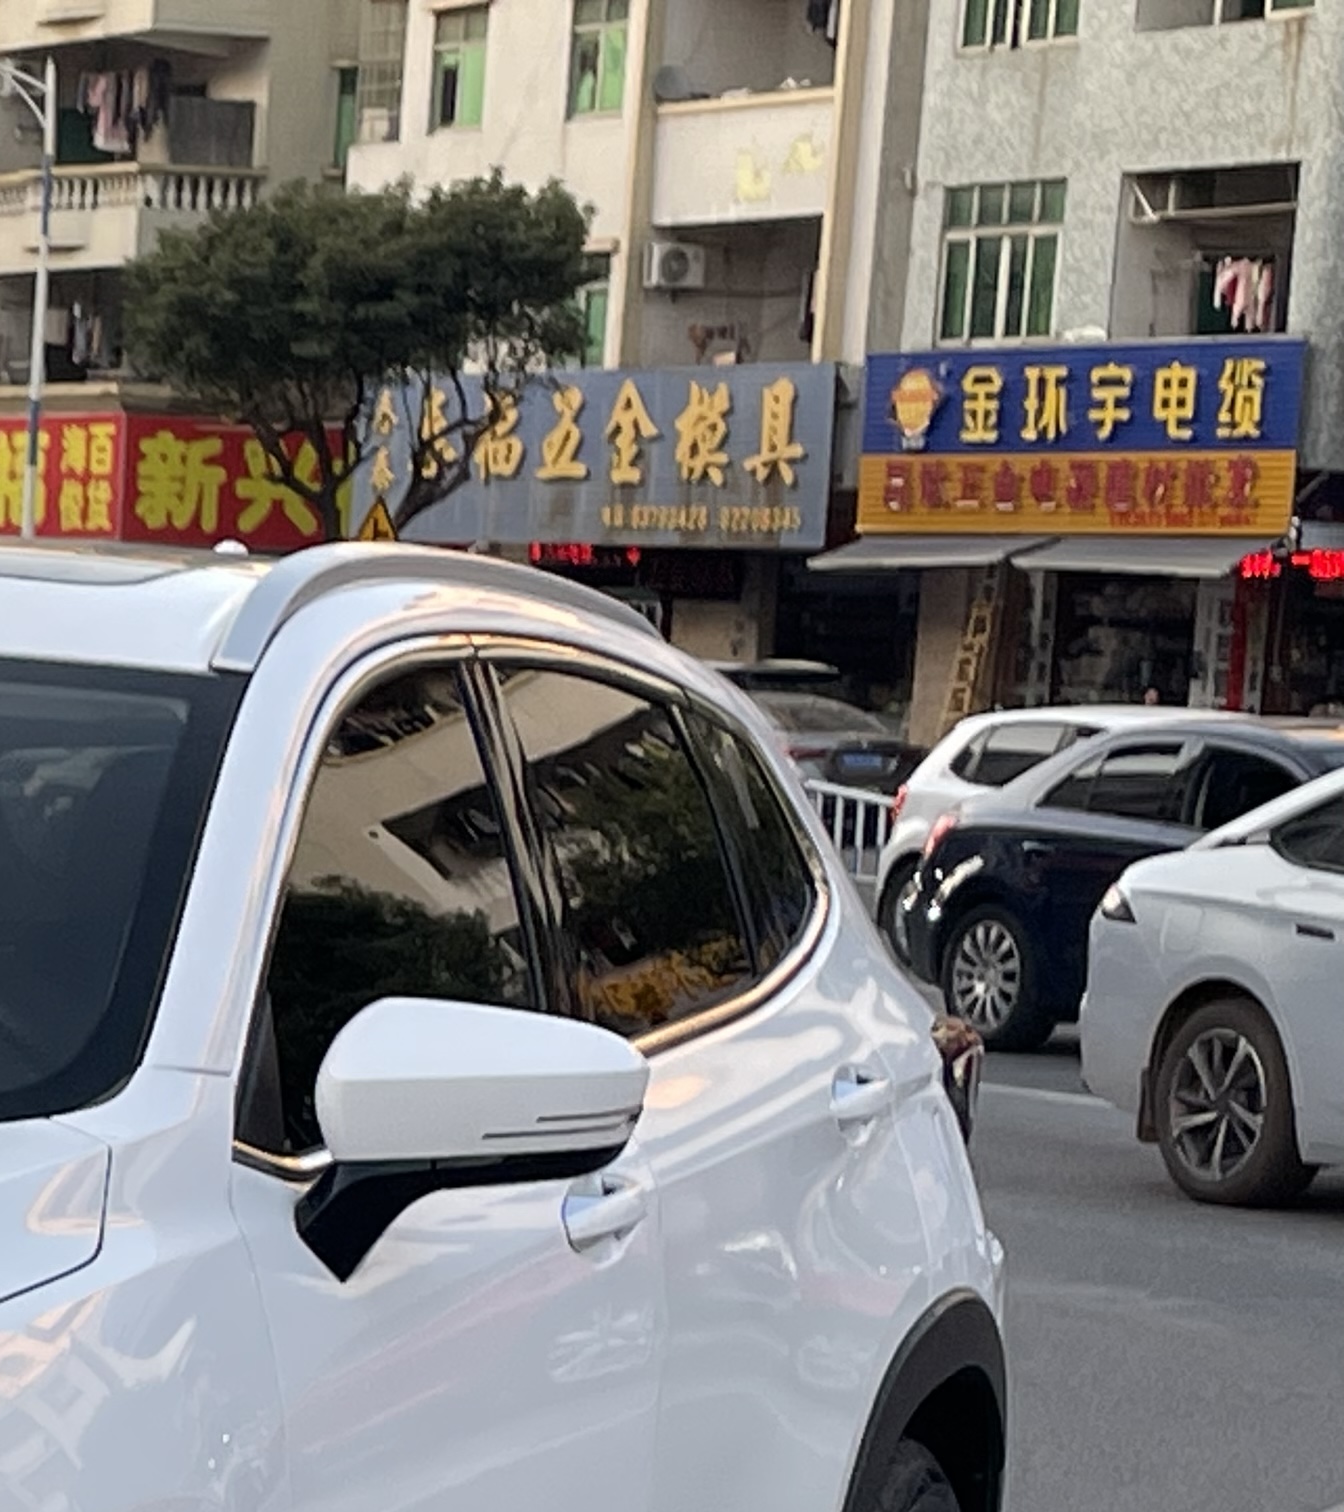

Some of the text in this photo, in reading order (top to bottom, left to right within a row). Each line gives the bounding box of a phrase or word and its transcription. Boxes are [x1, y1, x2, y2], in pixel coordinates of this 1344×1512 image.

[959, 357, 1267, 443] 金环宇电缆
[134, 429, 354, 537] 新兴
